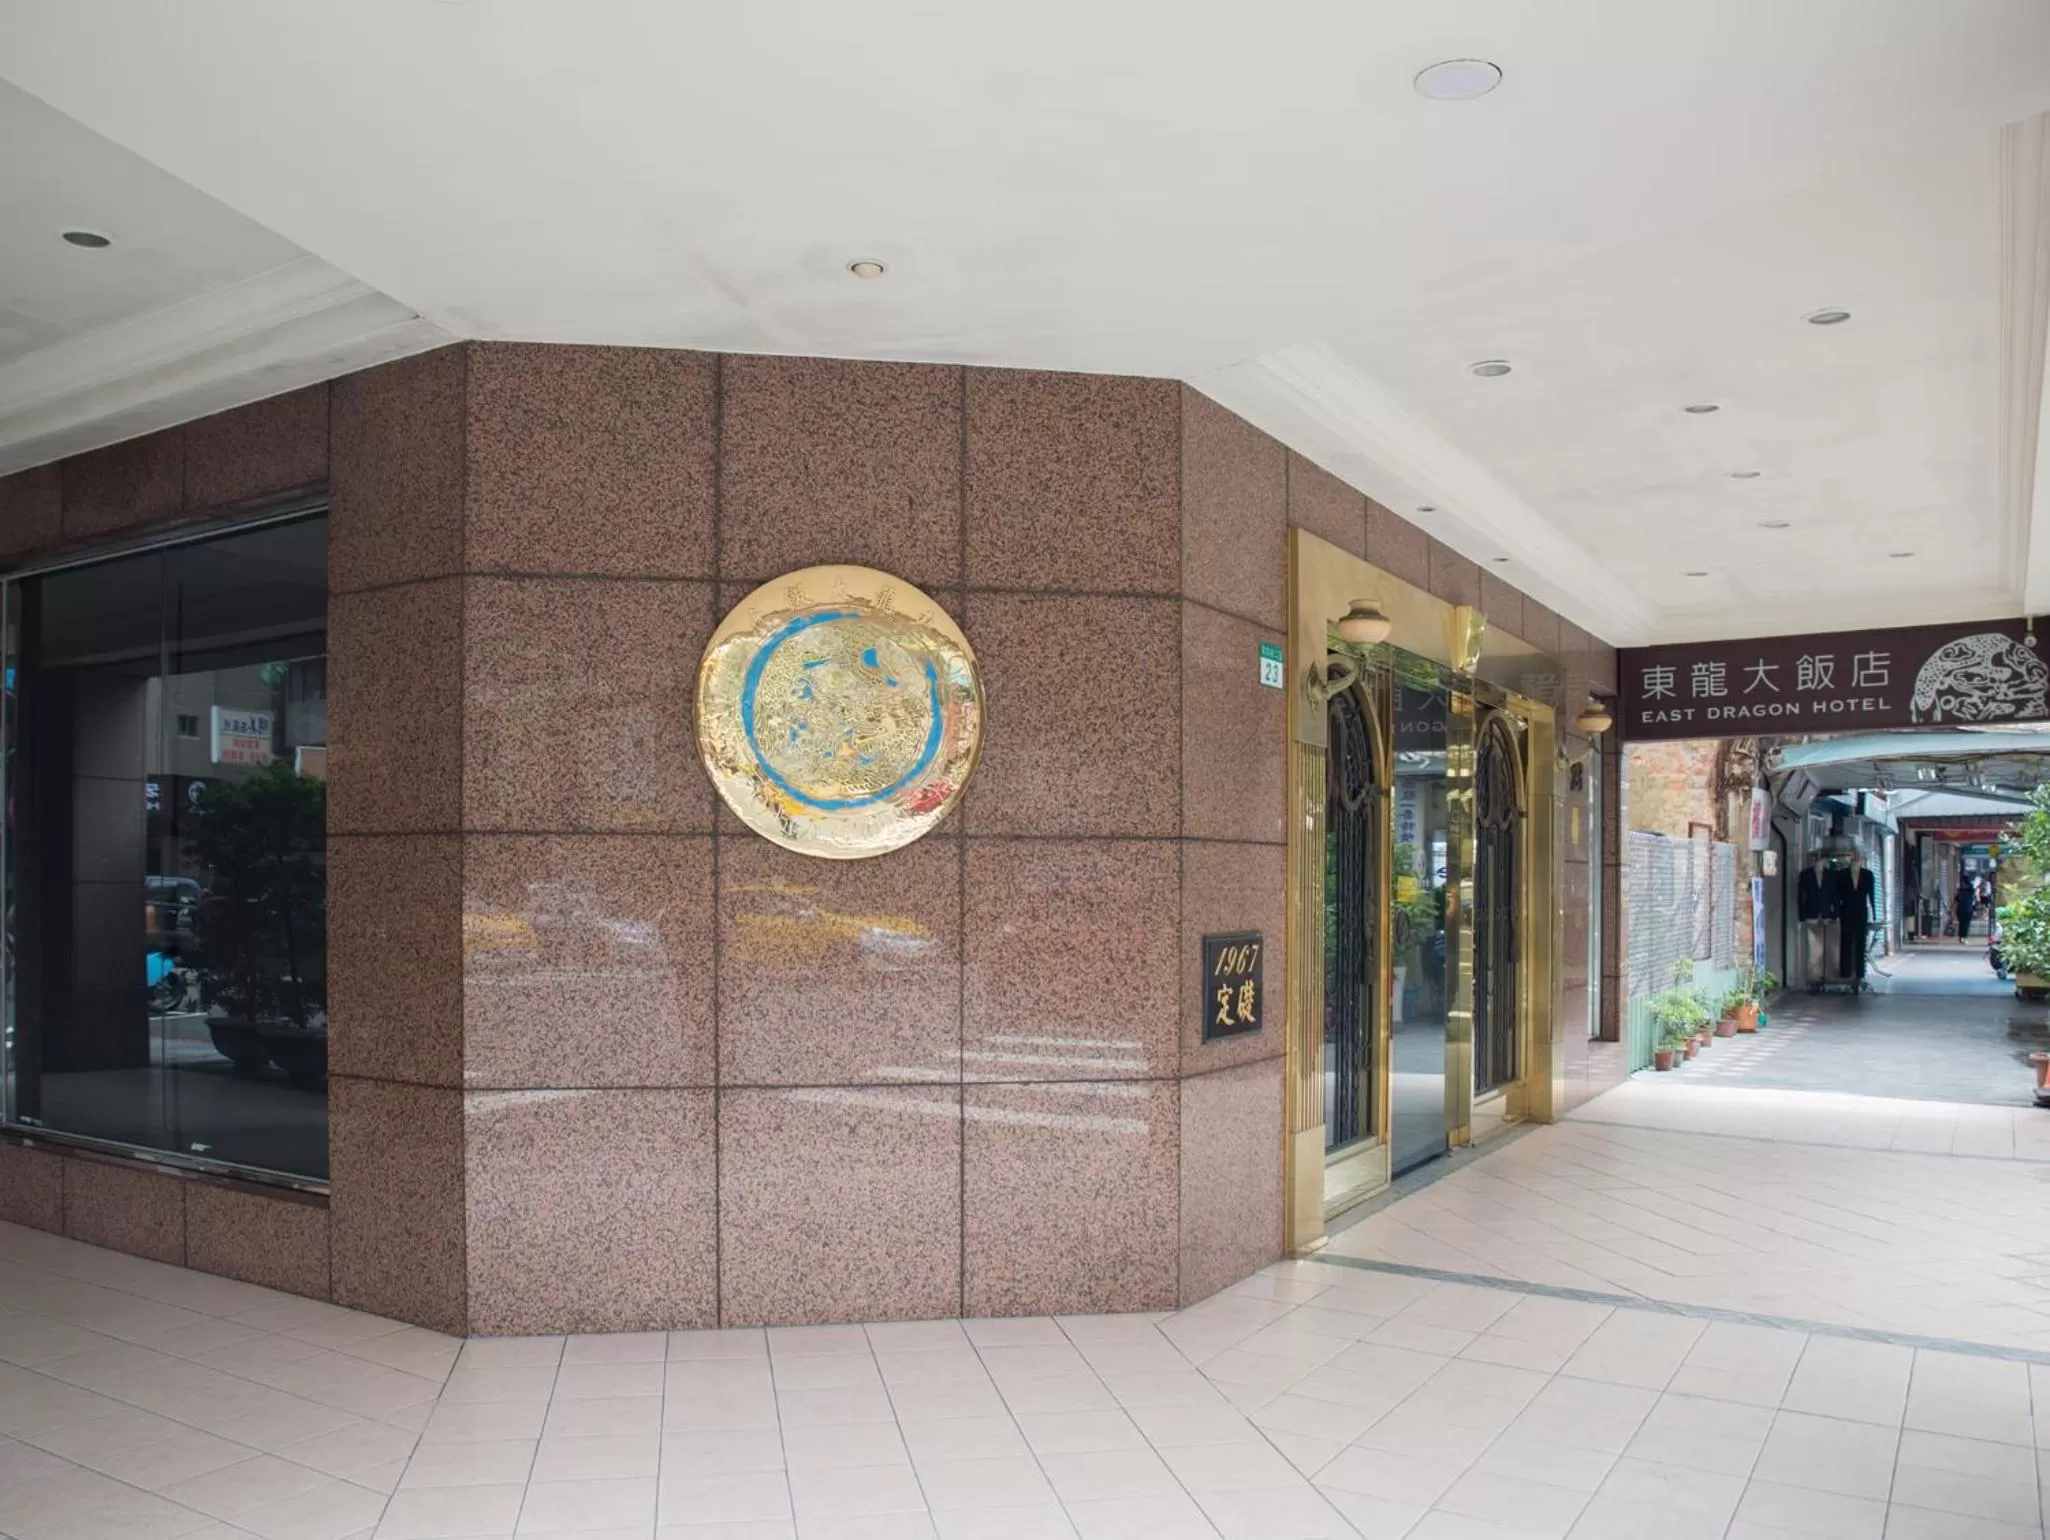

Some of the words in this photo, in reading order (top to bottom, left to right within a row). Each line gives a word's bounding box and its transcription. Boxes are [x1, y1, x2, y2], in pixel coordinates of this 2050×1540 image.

[1264, 662, 1280, 683] 23
[1641, 651, 1892, 700] 東龍大飯店
[1642, 708, 1695, 723] EAST
[1707, 702, 1800, 719] DRAGON
[1813, 697, 1892, 713] HOTEL
[1214, 944, 1259, 976] 1967
[1215, 979, 1256, 1026] 定礎
